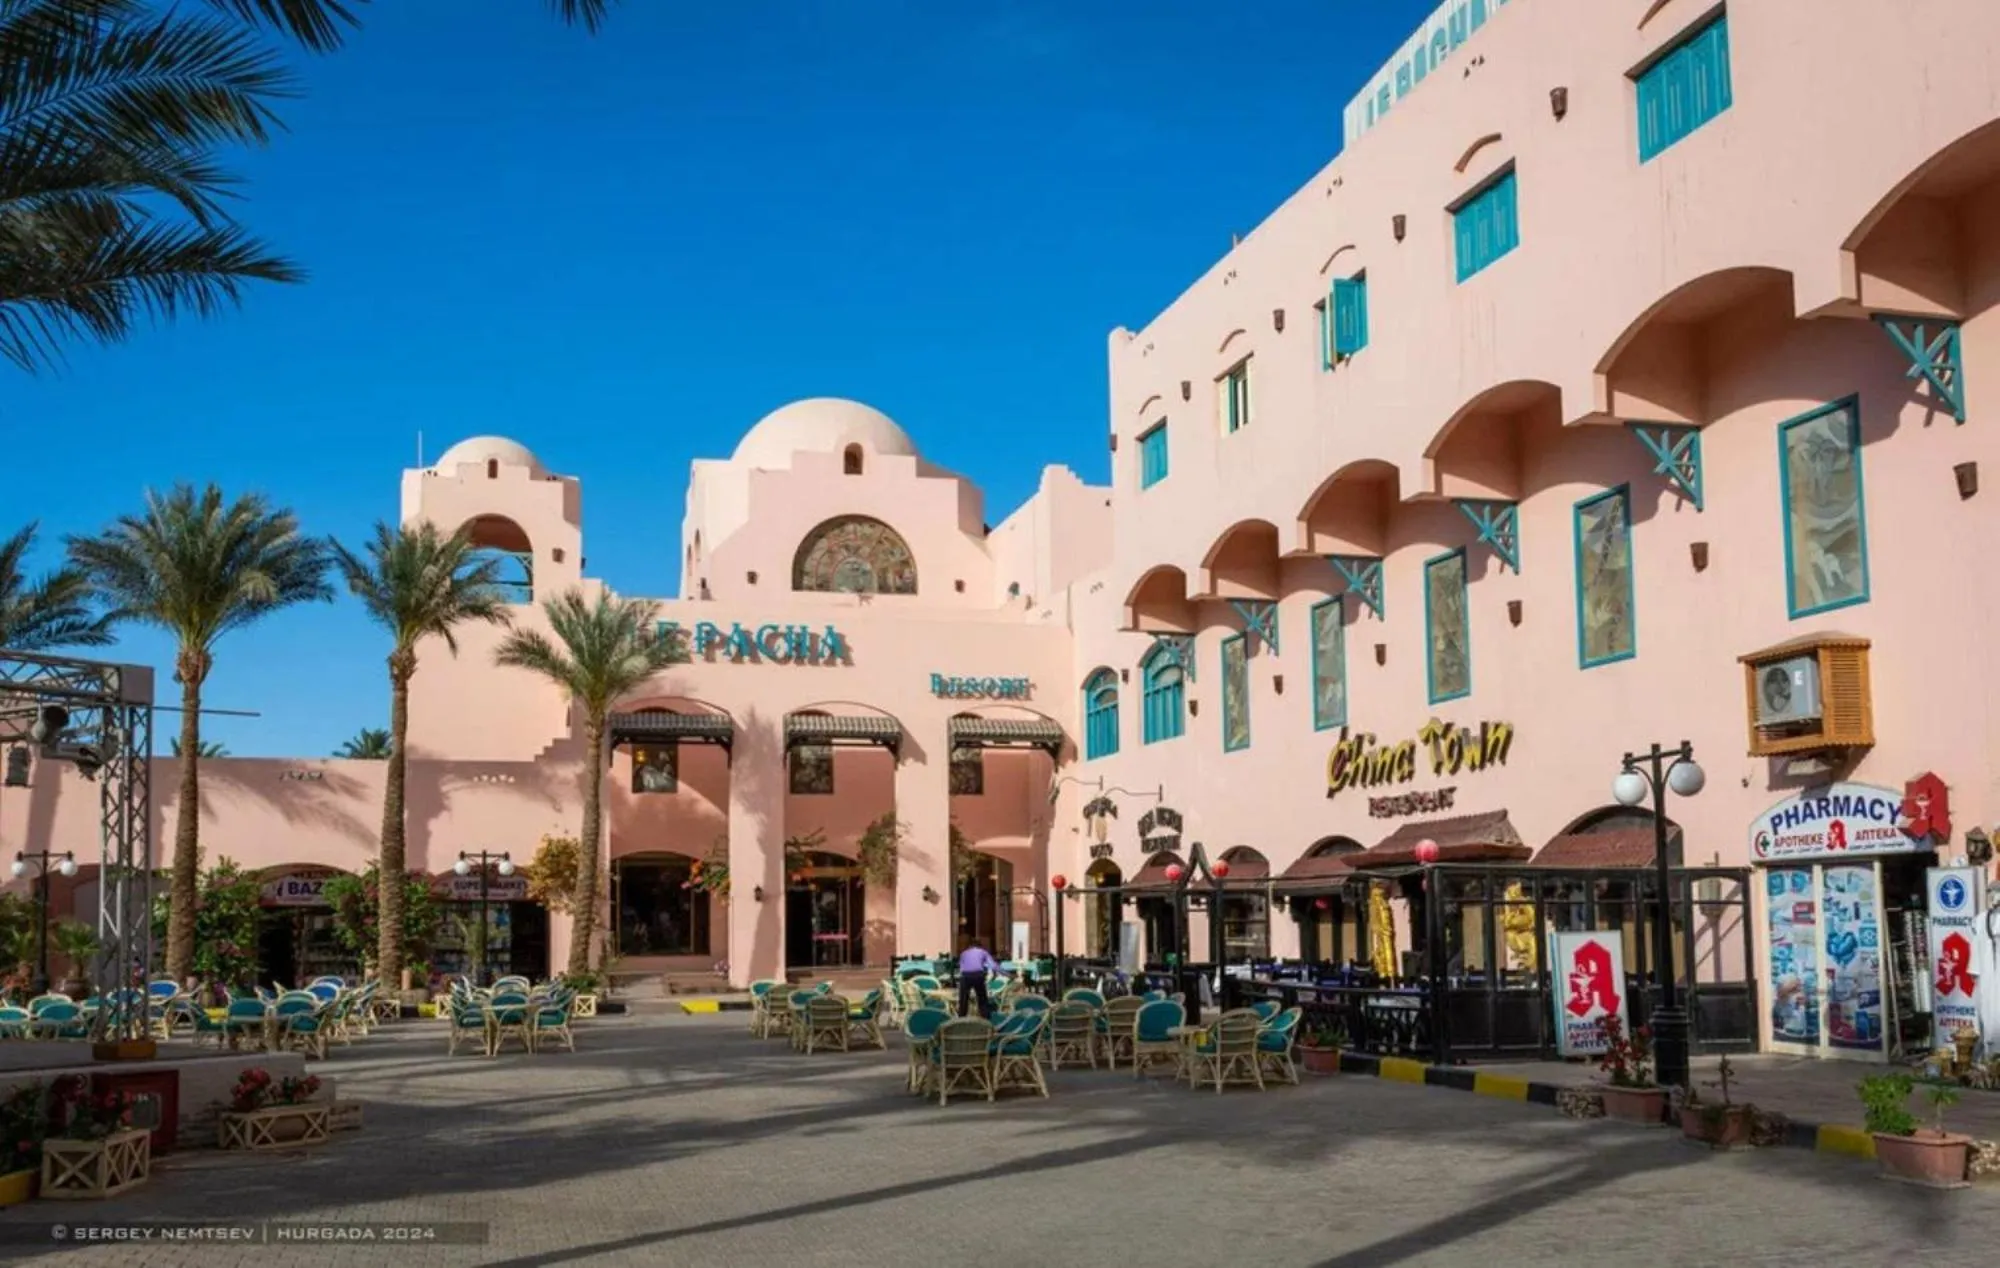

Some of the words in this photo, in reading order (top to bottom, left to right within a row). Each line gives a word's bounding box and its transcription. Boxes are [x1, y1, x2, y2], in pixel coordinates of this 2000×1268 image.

[693, 621, 844, 658] PACHA
[1327, 728, 1416, 799] China
[1769, 794, 1904, 836] PHARMACY
[1773, 832, 1824, 849] APOTHEKE
[1854, 827, 1897, 841] АПТЕКА
[288, 881, 324, 896] BAZ
